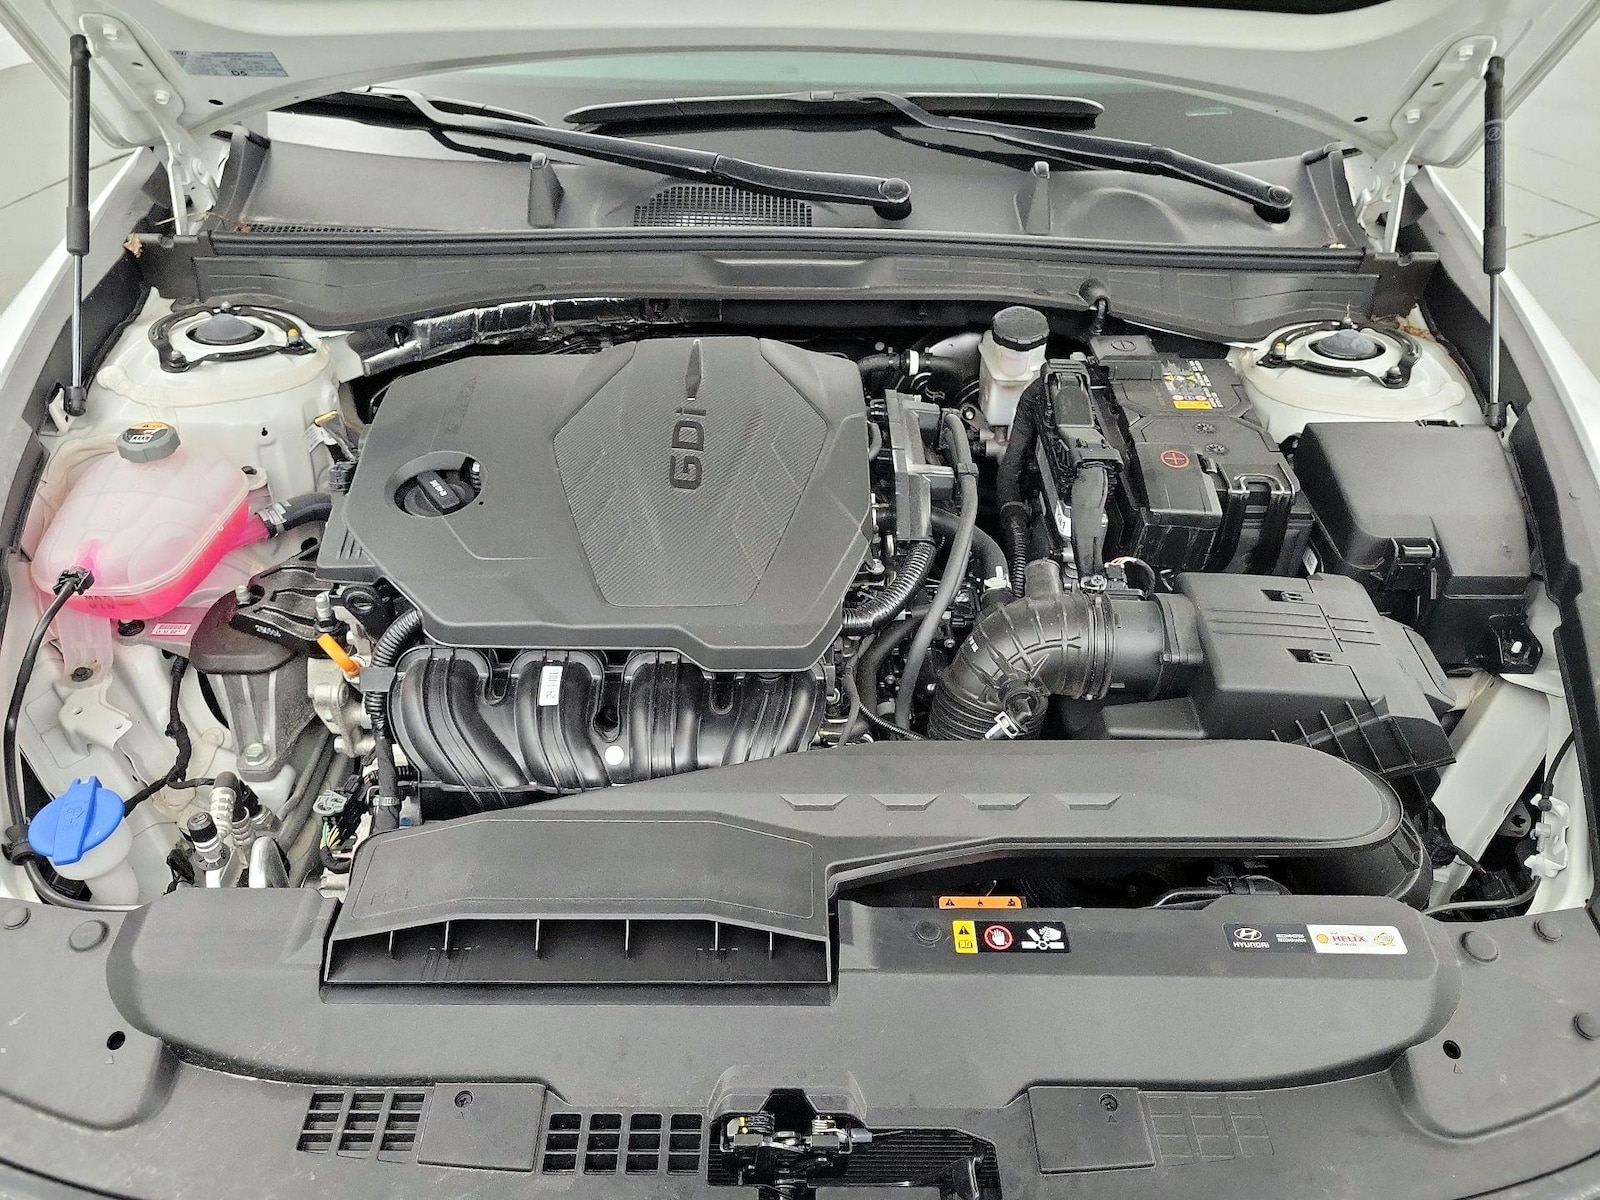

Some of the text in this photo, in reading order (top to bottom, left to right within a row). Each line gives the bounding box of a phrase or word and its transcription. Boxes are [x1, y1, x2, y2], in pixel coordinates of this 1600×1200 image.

[669, 407, 707, 490] GDi
[1332, 934, 1367, 943] HELIX
[1232, 941, 1270, 949] HYUNDAI
